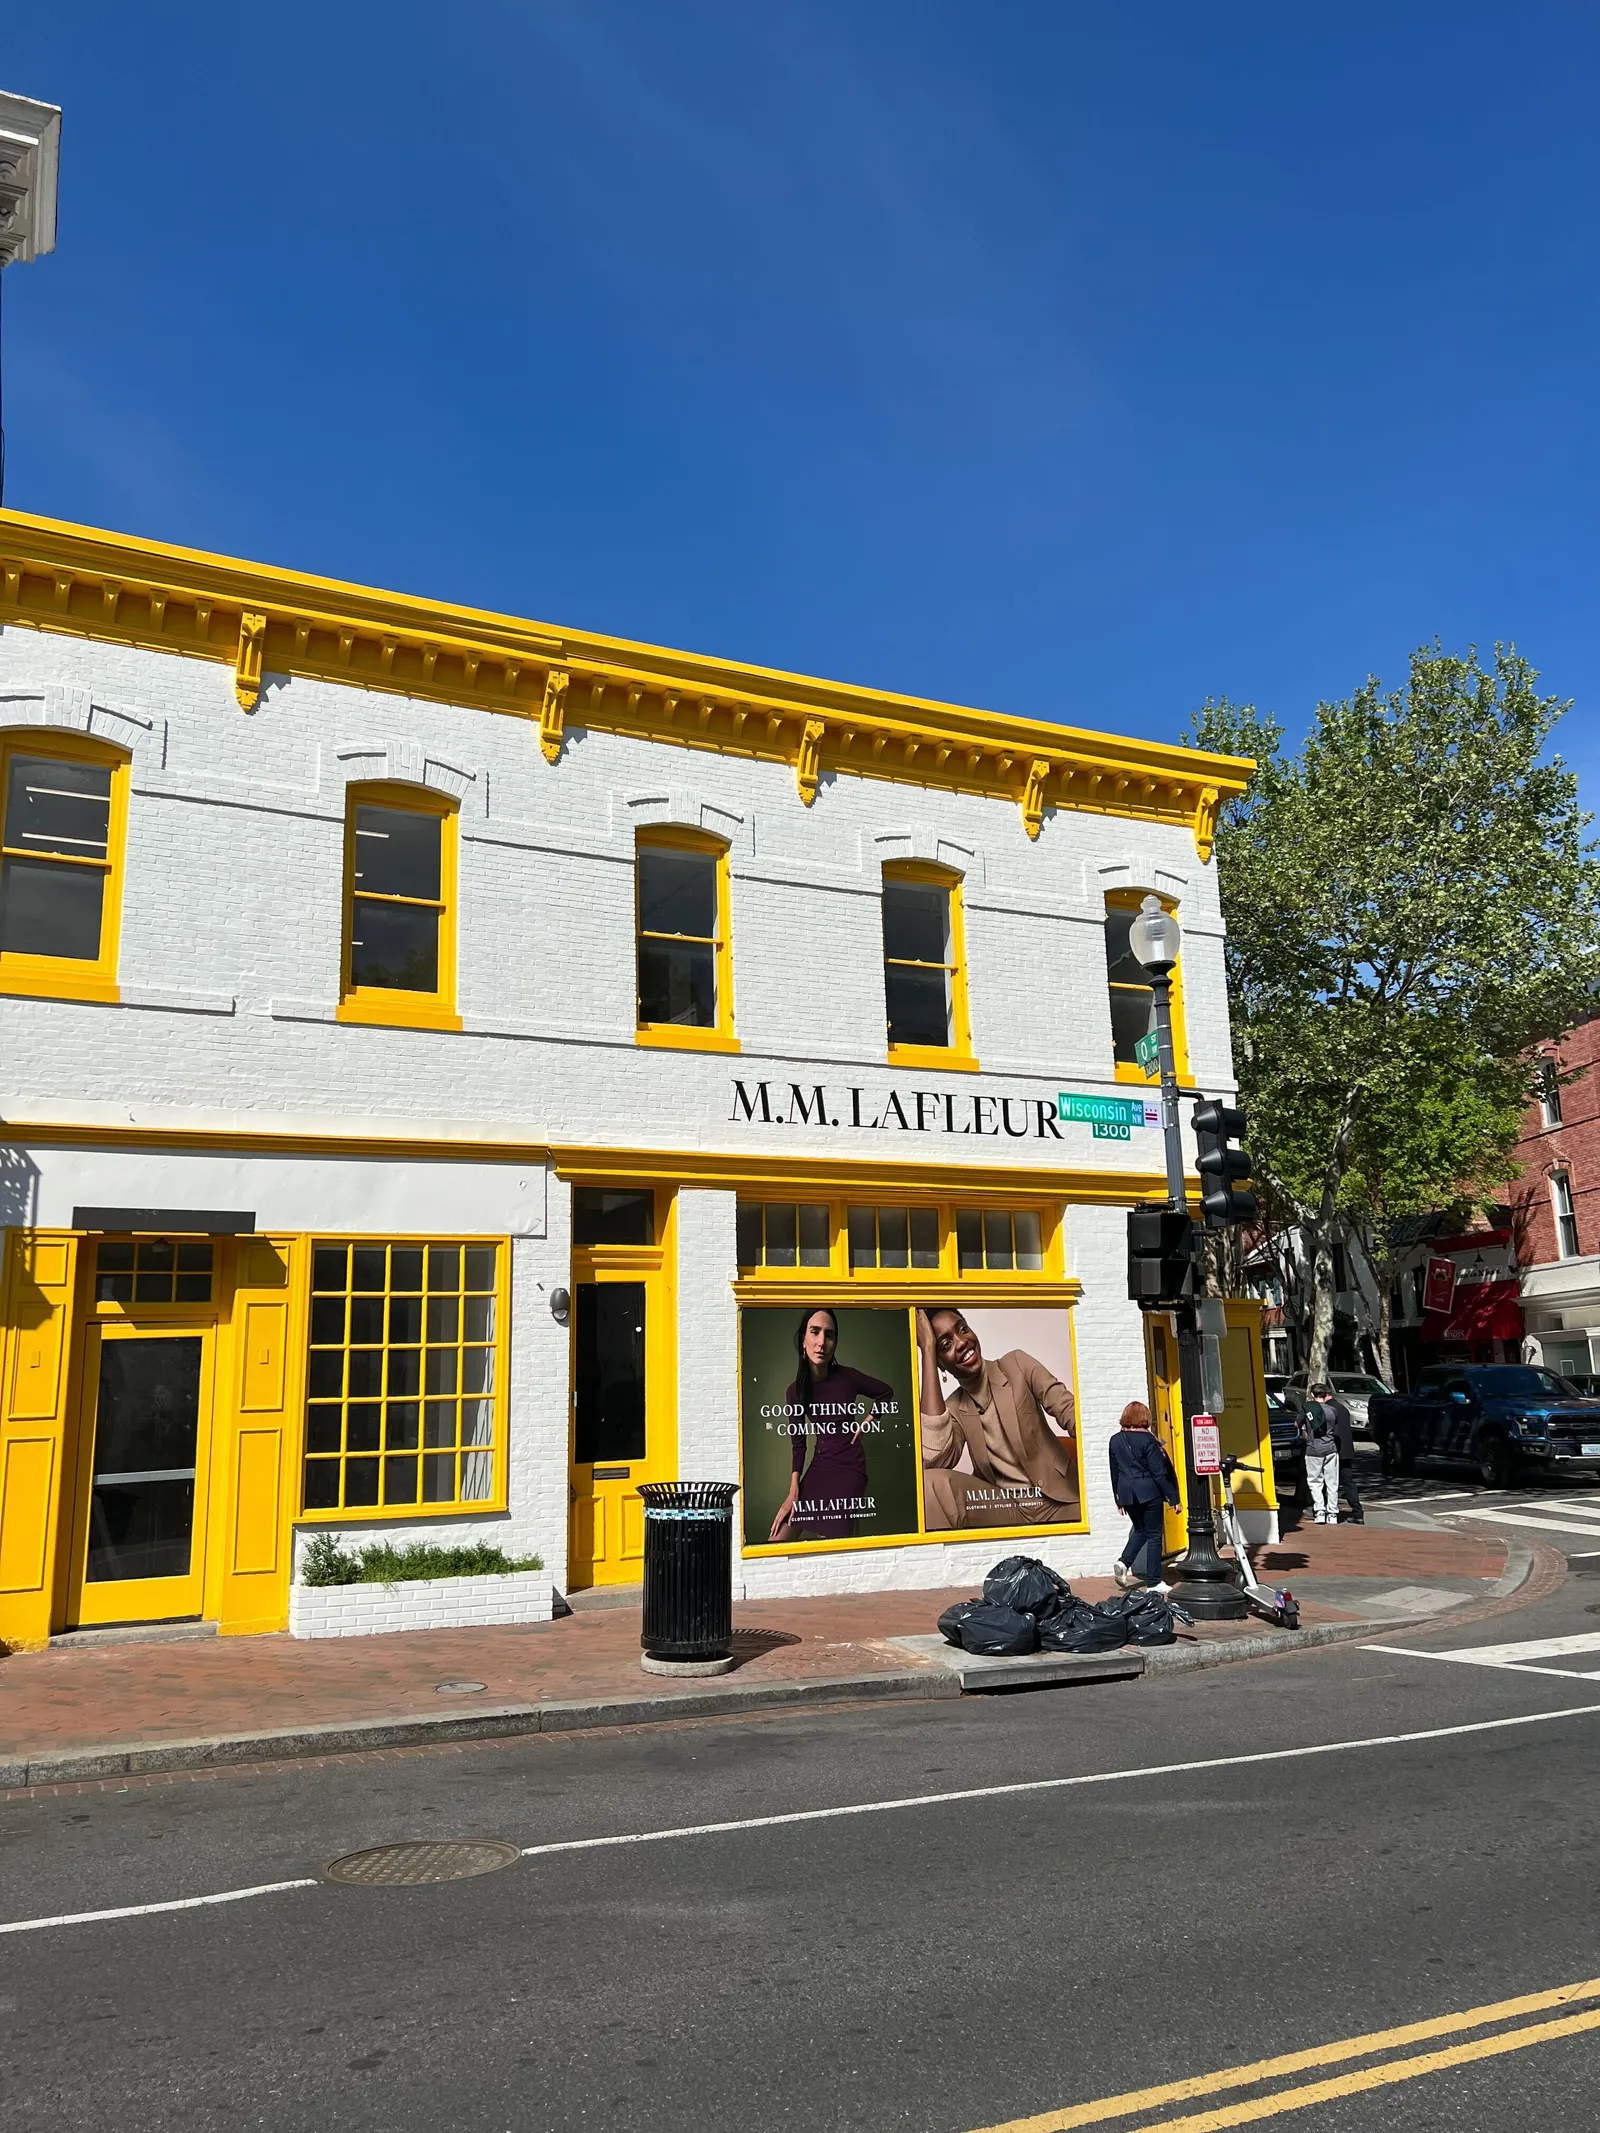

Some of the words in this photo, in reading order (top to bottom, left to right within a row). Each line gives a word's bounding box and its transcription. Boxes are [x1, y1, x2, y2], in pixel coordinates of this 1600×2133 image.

[1140, 1041, 1148, 1061] O
[728, 1079, 840, 1127] M.M.
[847, 1087, 1065, 1140] LAFLEUR
[1060, 1096, 1127, 1121] Wisconsin
[1131, 1102, 1143, 1113] Ave
[1132, 1114, 1142, 1125] NW
[1093, 1123, 1129, 1139] 1300
[760, 1404, 804, 1417] GOOD
[809, 1402, 865, 1416] THINGS
[870, 1401, 899, 1415] ARE
[777, 1422, 837, 1436] COMING
[842, 1420, 885, 1434] SOON.
[1202, 1427, 1209, 1435] NO
[966, 1489, 990, 1502] M.M.
[991, 1486, 1043, 1500] LAFLEUR
[792, 1500, 818, 1513] M.M.
[820, 1496, 876, 1512] LAFLEUR
